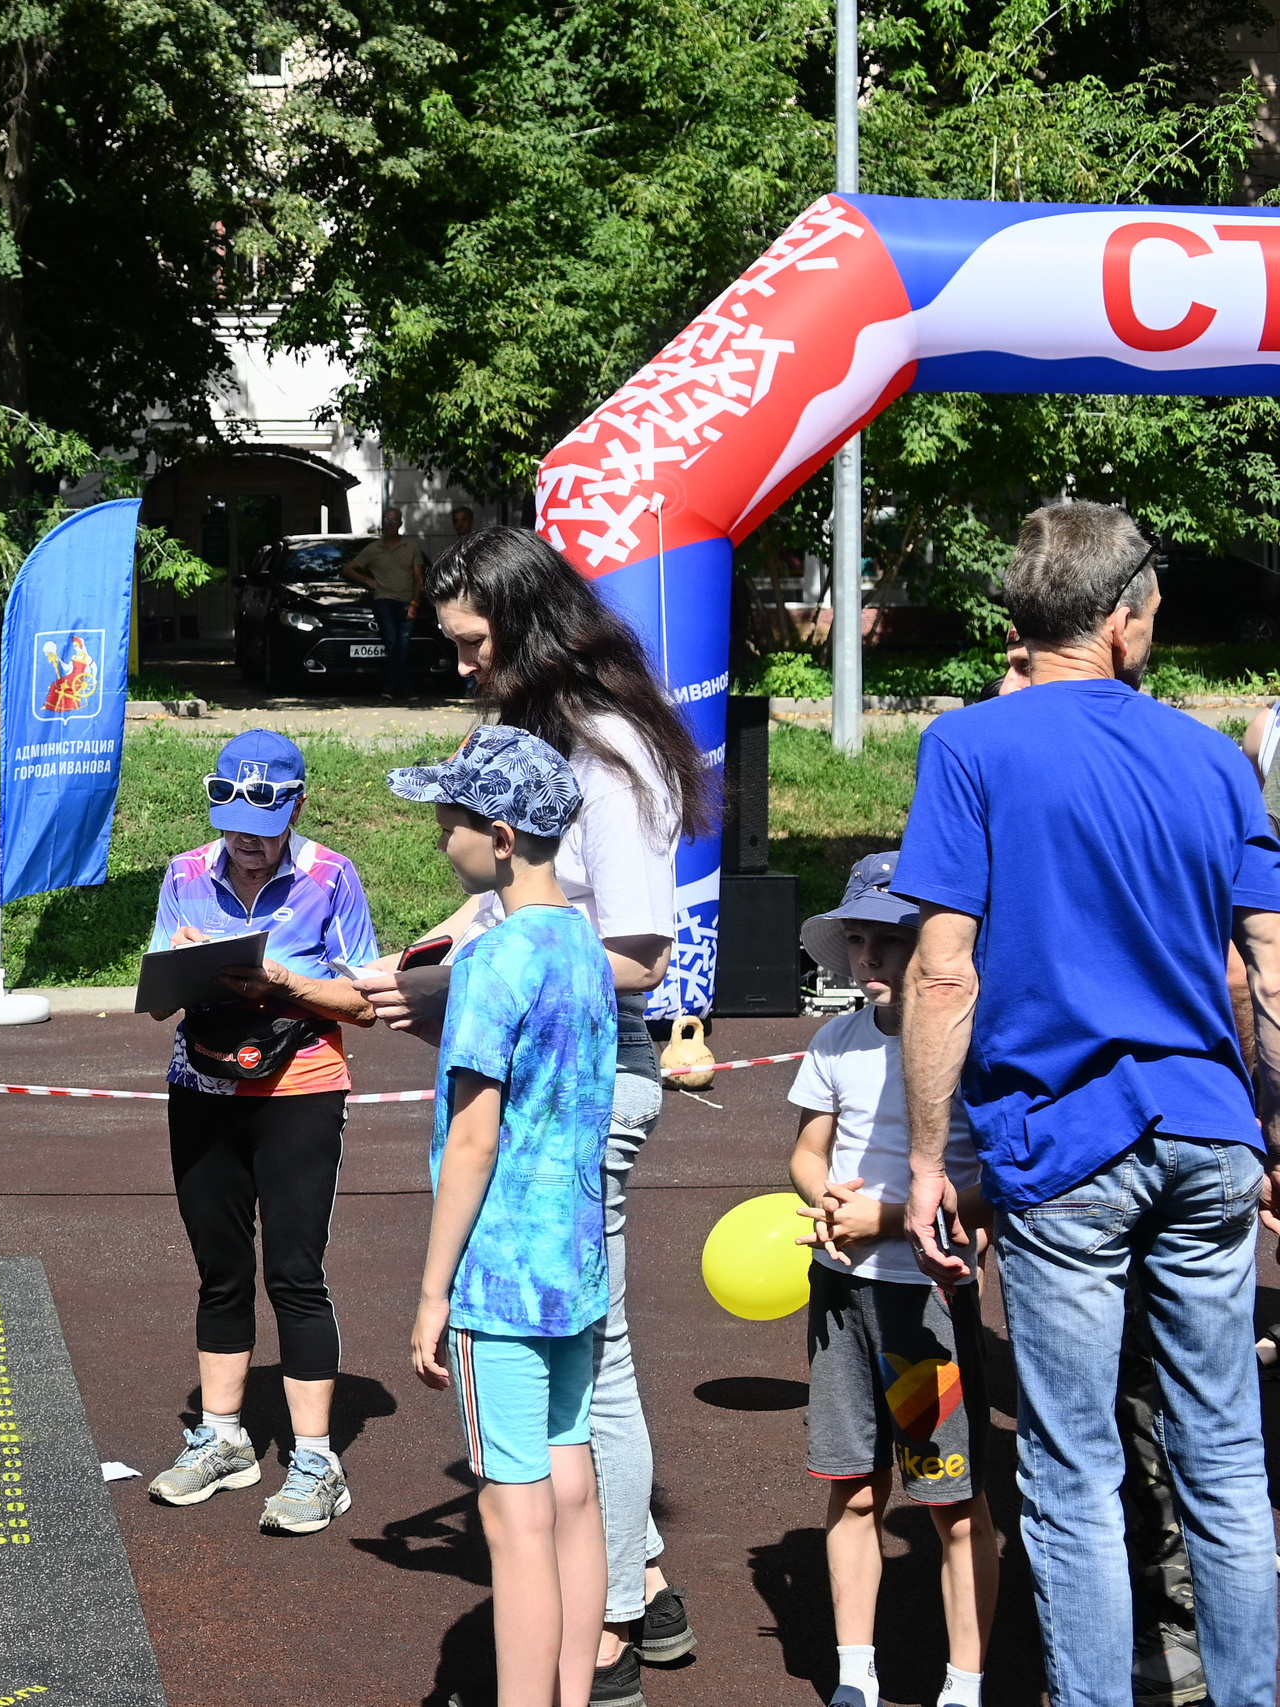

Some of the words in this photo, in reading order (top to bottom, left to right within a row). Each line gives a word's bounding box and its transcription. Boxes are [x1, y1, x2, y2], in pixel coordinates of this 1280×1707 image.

[15, 739, 115, 761] АДМИНИСТРАЦИЯ
[14, 762, 57, 781] ГОРОДА
[59, 759, 111, 775] ИВАНОВА
